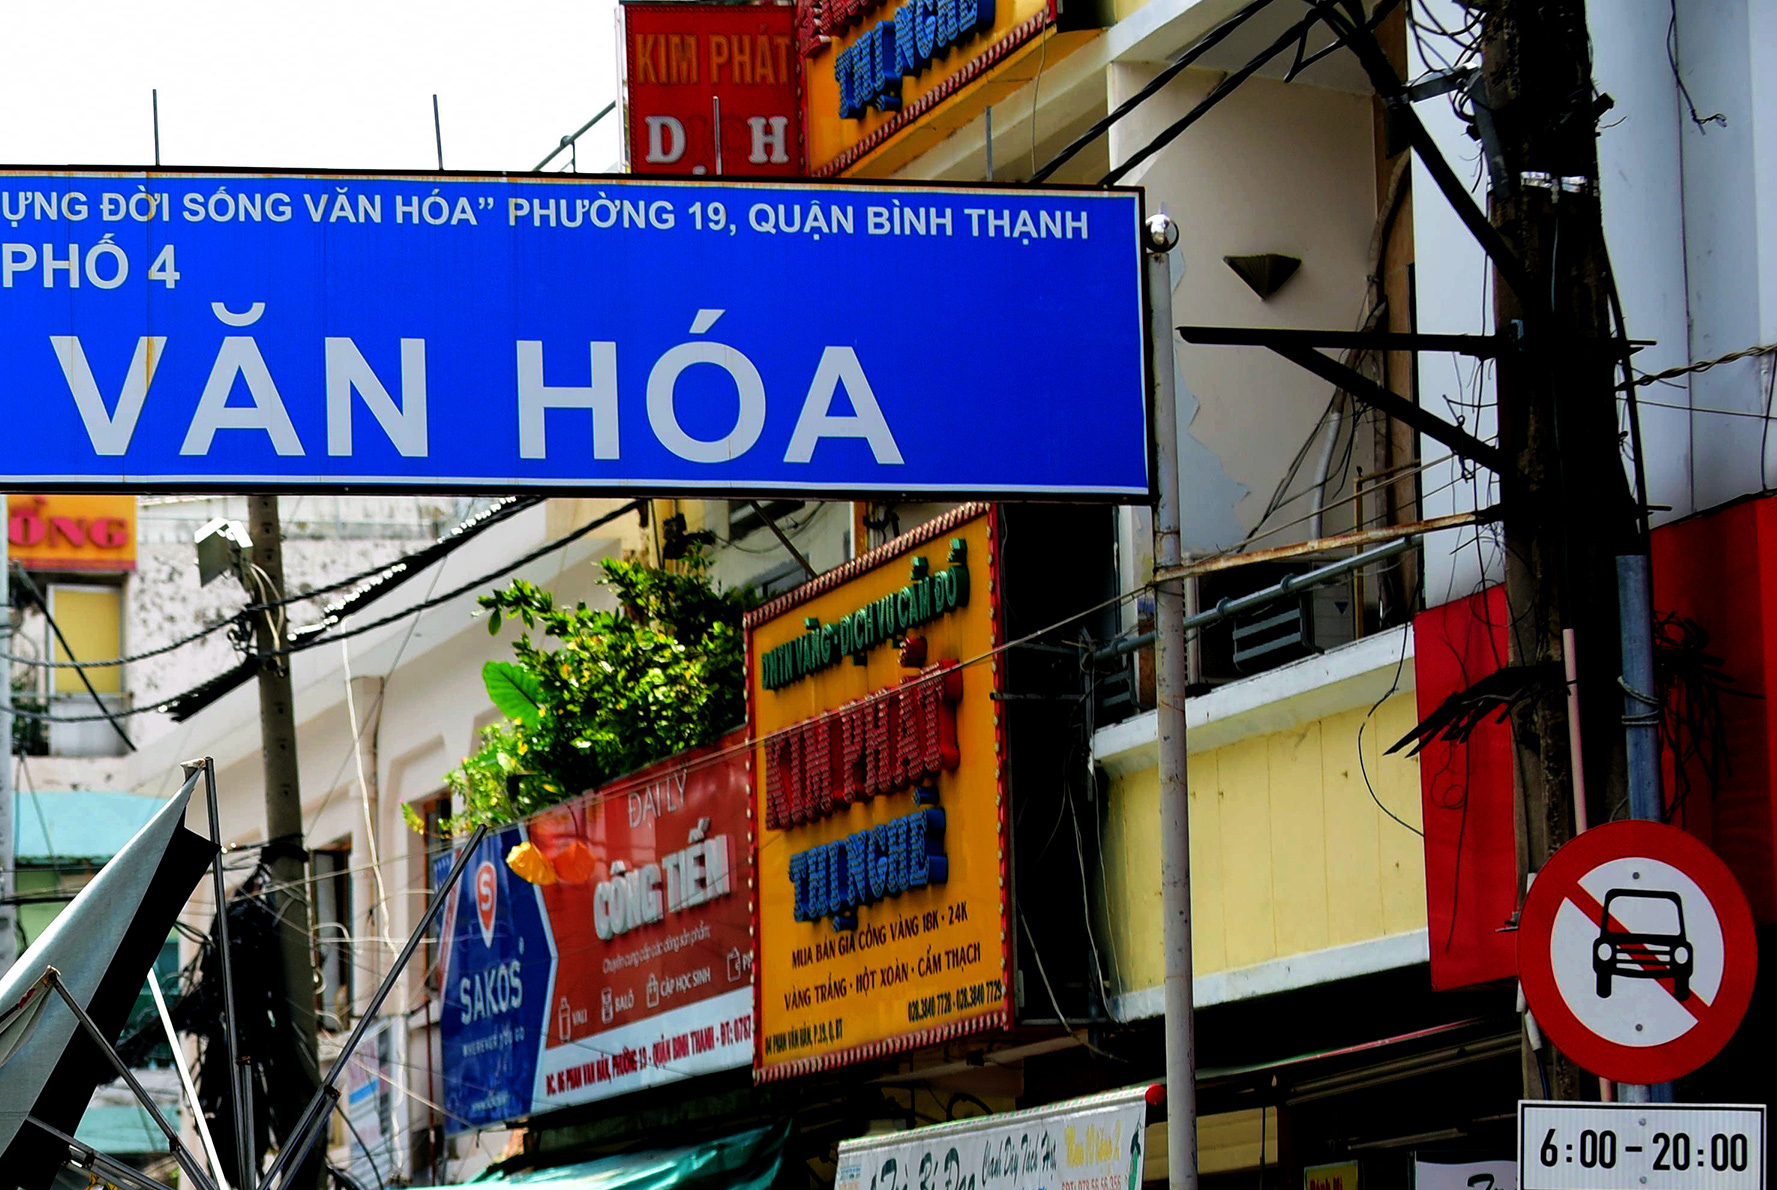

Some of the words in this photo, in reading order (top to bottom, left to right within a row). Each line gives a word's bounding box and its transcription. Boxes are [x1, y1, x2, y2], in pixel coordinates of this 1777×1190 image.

[636, 34, 699, 86] KIM
[709, 24, 794, 86] PHÁT
[100, 187, 170, 222] ĐỜI
[182, 184, 291, 222] SỐNG
[305, 184, 394, 223] VĂN
[509, 195, 674, 230] PHƯỜNG
[689, 200, 738, 237] 19,
[749, 199, 854, 240] QUẬN
[867, 198, 953, 236] BÌNH
[964, 208, 1088, 247] THẠNH
[3, 234, 128, 288] PHỐ
[149, 245, 180, 288] 4
[50, 303, 427, 456] VĂN
[517, 310, 904, 463] HÓA
[763, 709, 834, 831] KIM
[593, 859, 664, 941] CÔNG
[661, 816, 732, 914] TIẾN
[792, 948, 814, 970] MUA
[815, 935, 836, 963] BÁN
[838, 936, 856, 958] GIA
[858, 923, 887, 951] CÔNG
[890, 913, 920, 944] VÀNG
[923, 912, 939, 934] 18K
[948, 901, 968, 926] 24K
[459, 959, 523, 1026] SAKOS
[784, 985, 812, 1012] VÀNG
[945, 940, 982, 973] THẠCH
[1540, 1128, 1617, 1169] 6:00
[1652, 1132, 1748, 1172] 20:00
